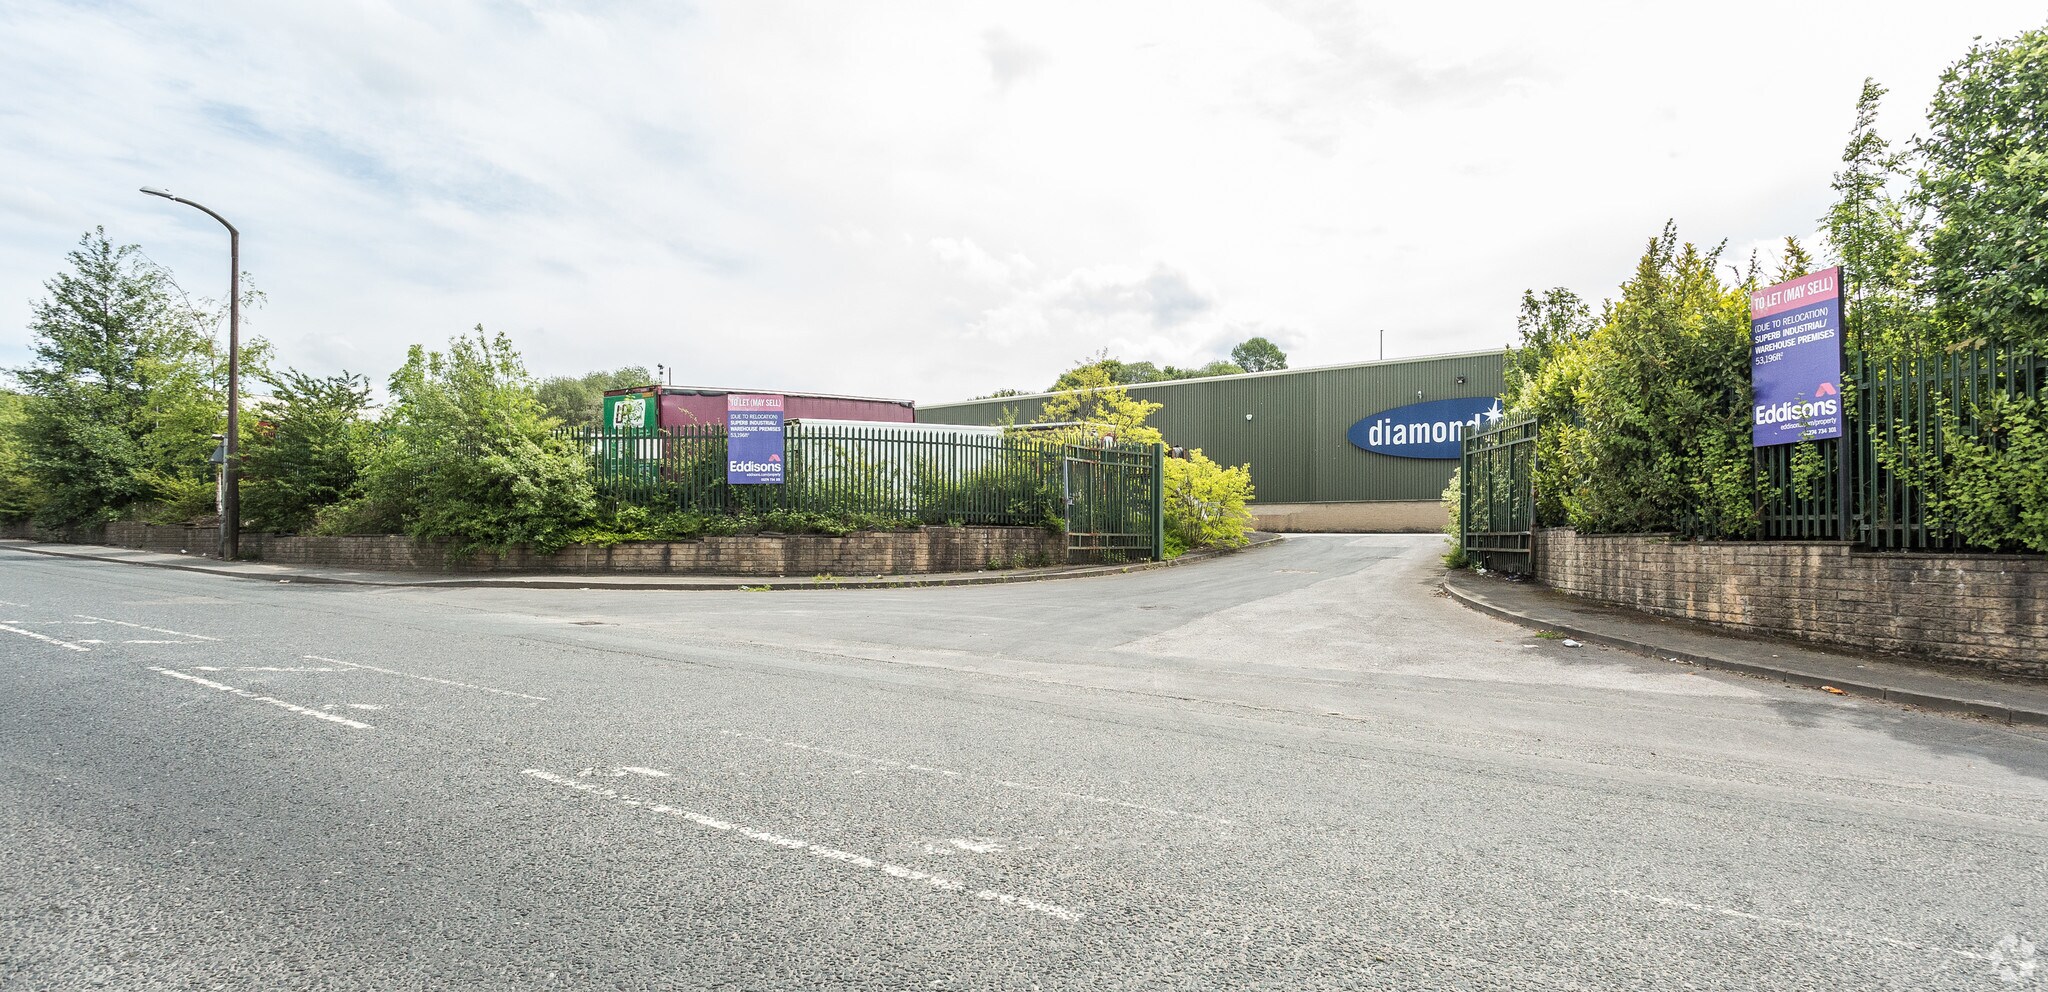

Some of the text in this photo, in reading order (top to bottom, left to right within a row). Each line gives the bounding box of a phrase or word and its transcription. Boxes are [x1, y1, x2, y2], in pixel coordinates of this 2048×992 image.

[1754, 276, 1833, 311] TO LET (MAY SELL)
[1754, 307, 1828, 334] (DUE TO RELOCATION)
[1754, 319, 1827, 344] SUPERB INDUSTRIAL/
[1754, 329, 1835, 355] WAREHOUSE PREMISES
[739, 398, 750, 406] LET
[750, 398, 765, 407] (MAY
[765, 399, 781, 407] SELL)
[1755, 399, 1837, 425] Eddisons
[730, 460, 781, 472] Eddisons
